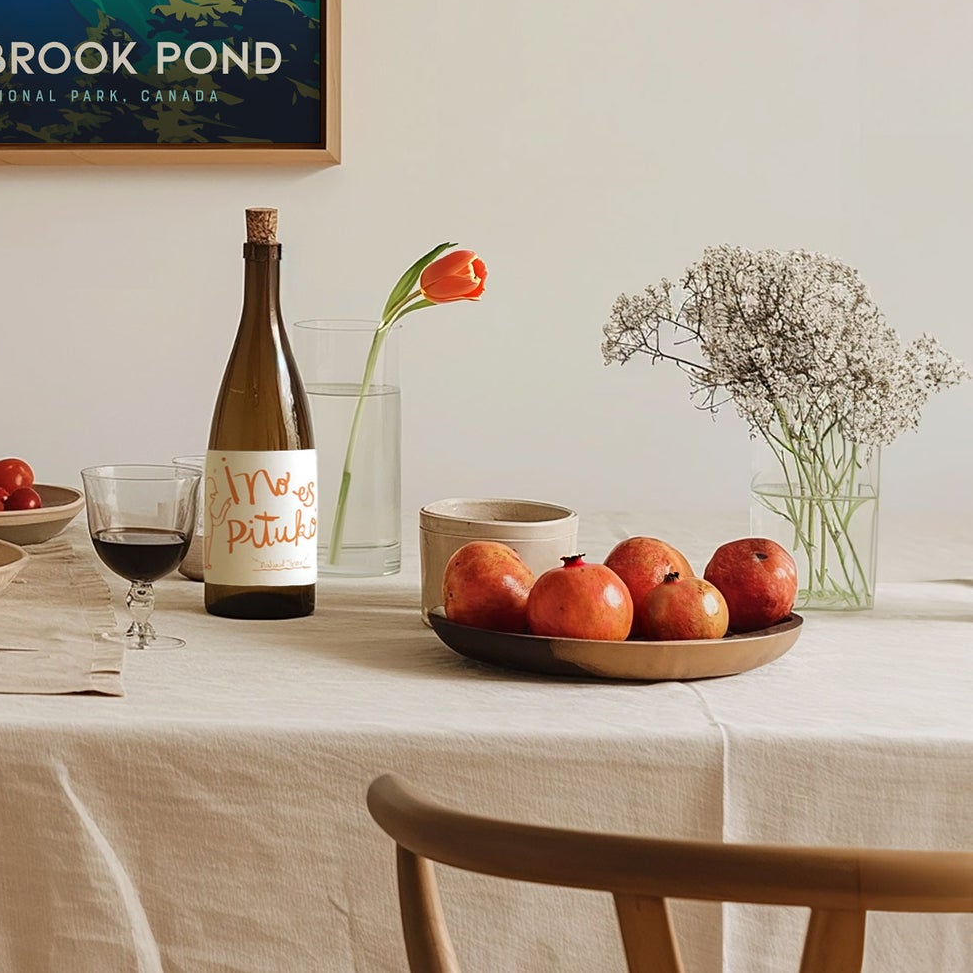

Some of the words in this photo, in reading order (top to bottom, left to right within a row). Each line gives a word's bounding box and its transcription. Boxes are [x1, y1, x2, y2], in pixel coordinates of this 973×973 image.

[157, 41, 282, 75] POND
[71, 89, 127, 104] PARK,
[141, 89, 219, 102] CANADA
